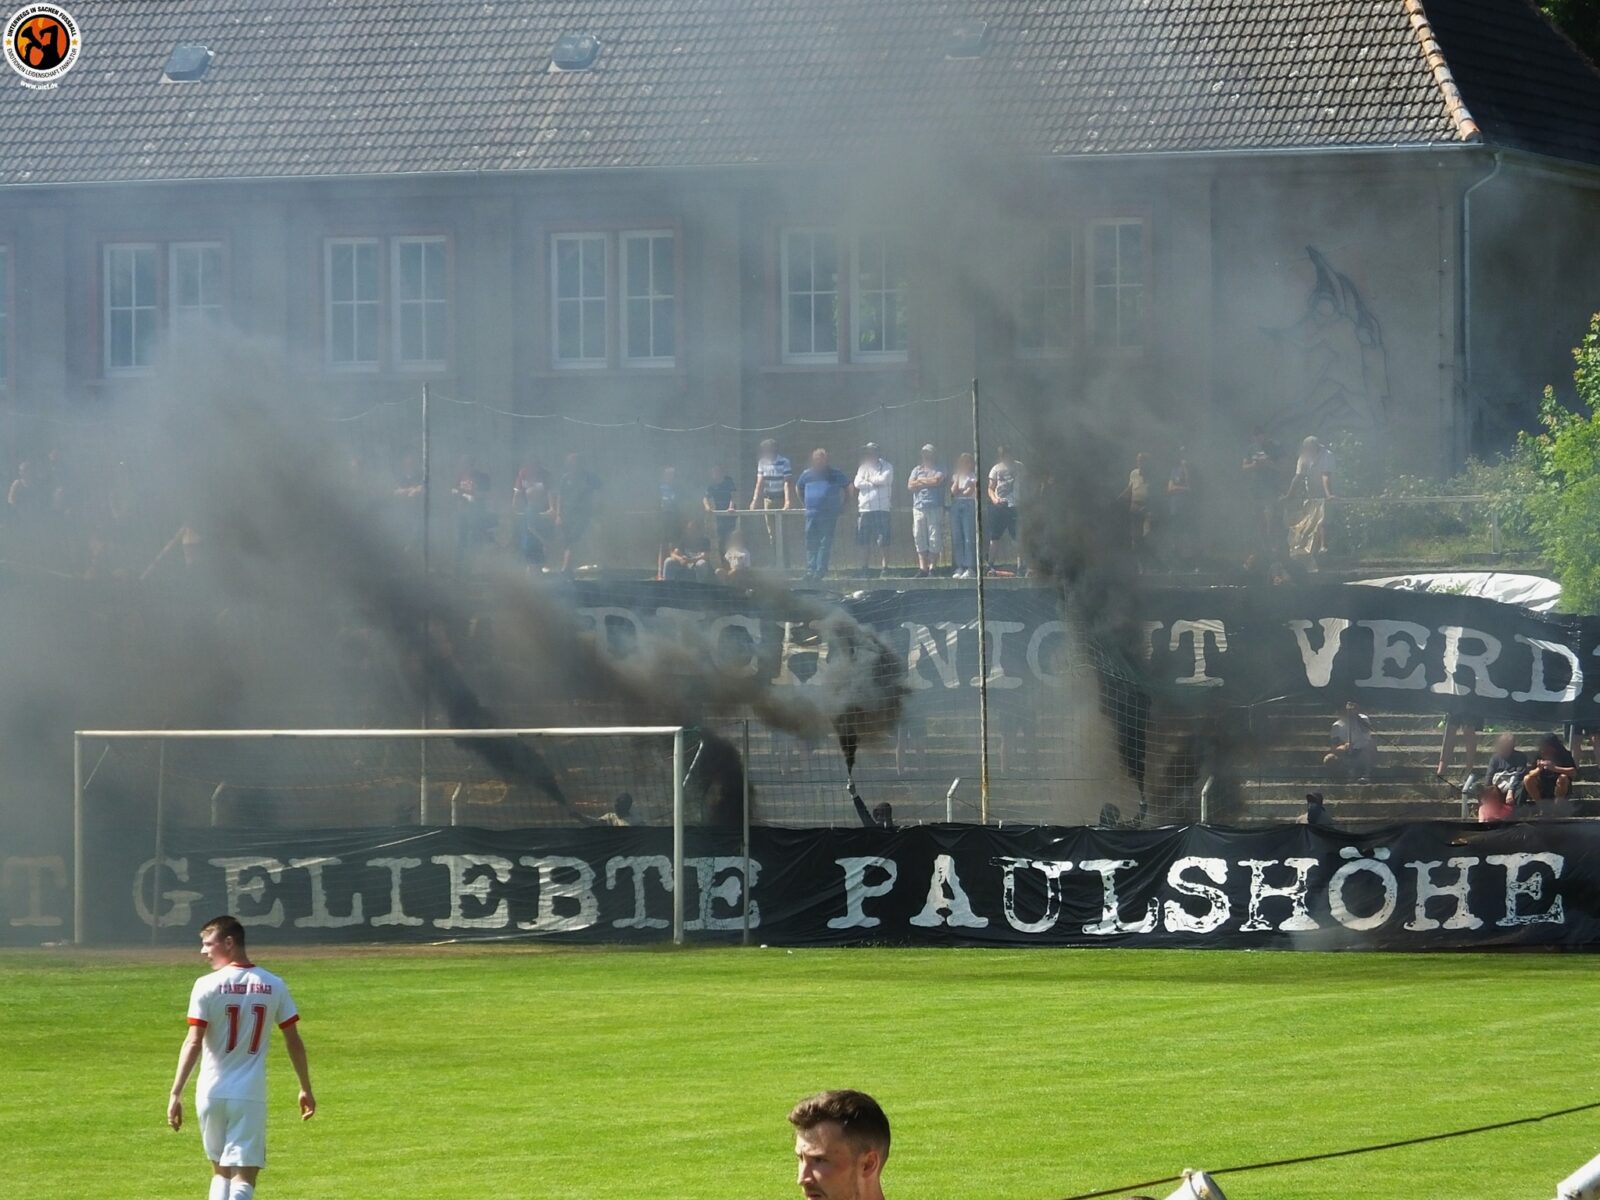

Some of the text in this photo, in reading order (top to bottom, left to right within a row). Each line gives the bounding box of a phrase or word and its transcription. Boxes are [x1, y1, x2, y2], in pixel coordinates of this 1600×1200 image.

[900, 619, 1228, 690] NICT
[1288, 618, 1600, 702] VERD
[133, 854, 762, 932] GELIEBTE
[827, 847, 1565, 935] PAULSHÖHE
[225, 1004, 268, 1055] 11
